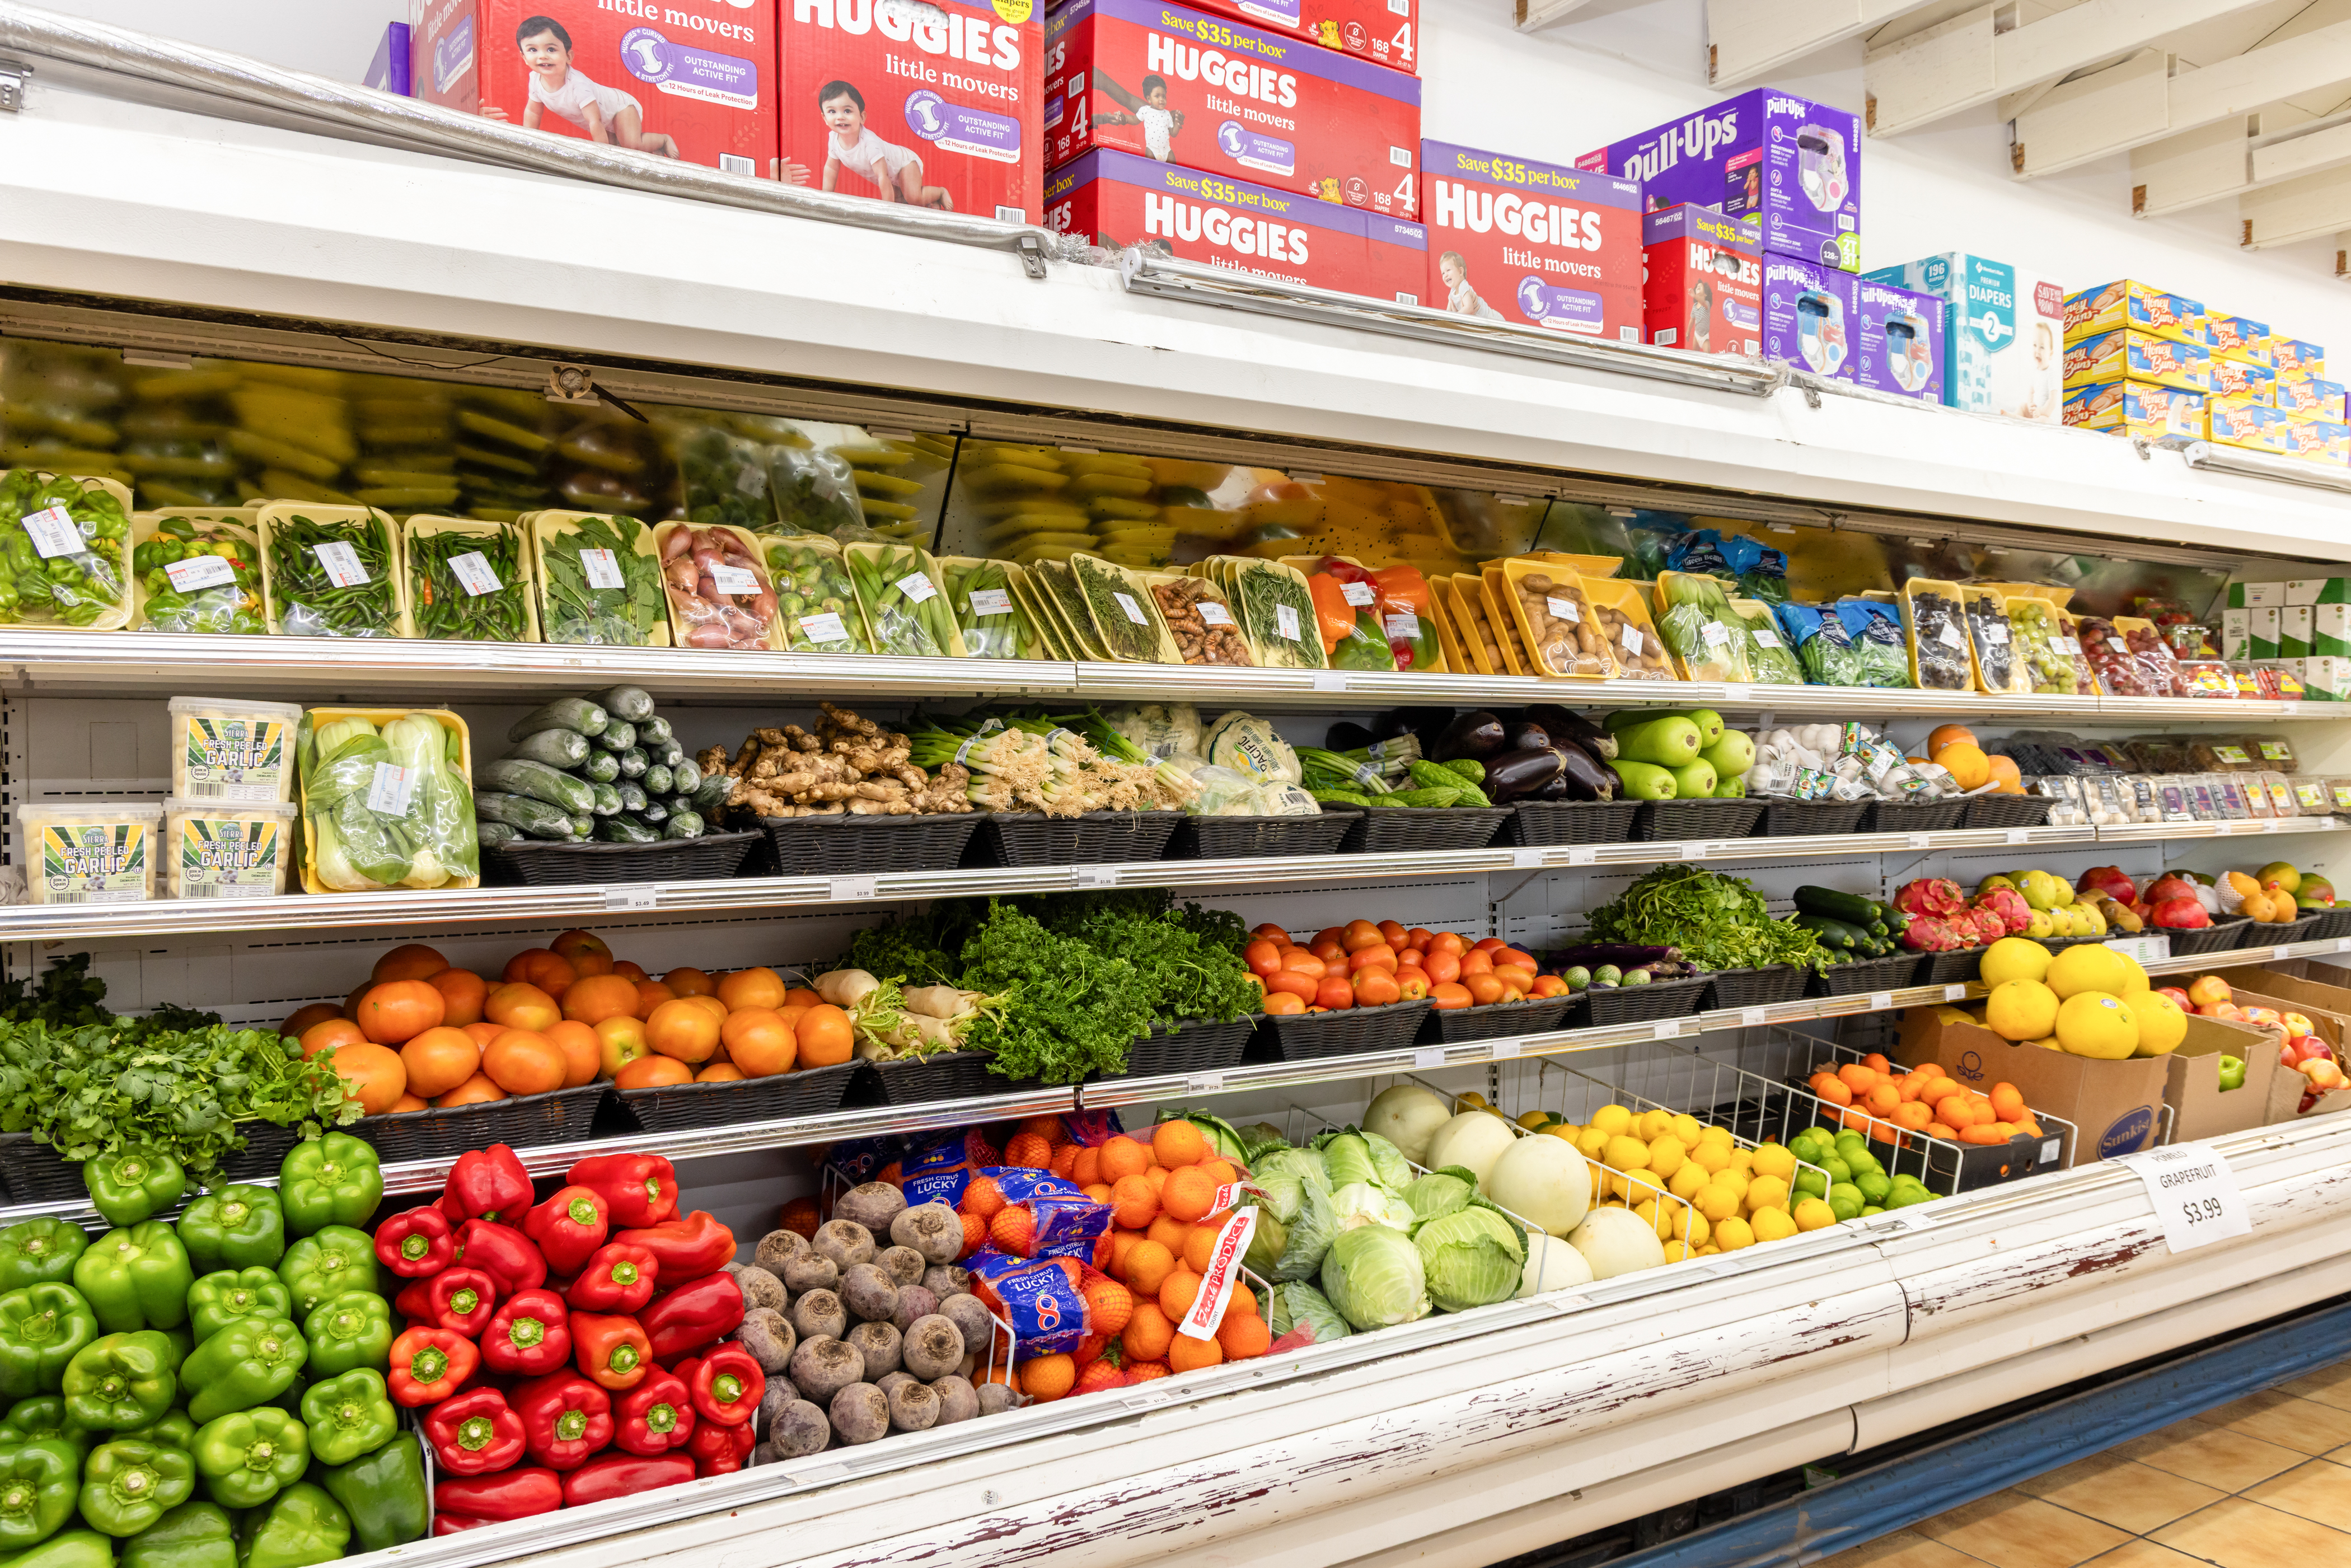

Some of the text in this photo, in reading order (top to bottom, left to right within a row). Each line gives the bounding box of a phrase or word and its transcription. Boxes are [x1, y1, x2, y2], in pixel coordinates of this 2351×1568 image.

[664, 8, 754, 43] movers
[1277, 13, 1297, 25] Protection
[642, 29, 666, 44] CURVED
[1162, 11, 1195, 32] Save
[1196, 18, 1231, 46] $35
[1233, 35, 1256, 50] per
[1372, 38, 1389, 53] 168
[1391, 22, 1413, 61] 4
[1373, 51, 1388, 60] DIAPERS
[641, 68, 670, 82] STRETCHY
[684, 56, 746, 76] OUTSTANDING
[692, 67, 738, 83] ACTIVE FIT
[1148, 32, 1297, 107] HUGGIES
[886, 54, 1019, 101] little movers
[677, 85, 696, 96] Hours
[705, 90, 720, 99] Leak
[721, 93, 753, 106] Protection
[923, 91, 943, 104] CURVED
[1071, 95, 1088, 140] 4
[1206, 93, 1295, 131] little movers
[958, 115, 1010, 133] OUTSTANDING
[965, 124, 1004, 140] ACTIVE FIT
[921, 128, 947, 140] STRETCHY
[952, 142, 967, 151] Hours
[975, 146, 988, 154] Leak
[989, 148, 1016, 160] Protection
[1057, 135, 1070, 152] 168
[1253, 139, 1289, 153] OUTSTANDING
[1258, 147, 1275, 156] ACTIVE
[1273, 165, 1291, 174] Protection
[1457, 153, 1489, 174] Save
[1491, 157, 1525, 184] $35
[1528, 170, 1549, 185] per
[1167, 171, 1198, 193] Save
[1201, 177, 1235, 204] $35
[1237, 192, 1259, 208] per
[1393, 173, 1416, 212] 4
[1613, 181, 1637, 193] 5646602
[1374, 191, 1391, 205] 168
[1374, 204, 1389, 213] DIAPERS
[1435, 180, 1602, 251] HUGGIES
[1145, 193, 1309, 265] HUGGIES
[1697, 218, 1746, 245] Save $35 per
[1503, 246, 1601, 279] little movers
[1928, 263, 1945, 277] 196
[1557, 294, 1596, 306] OUTSTANDING
[1717, 280, 1759, 302] little movers
[1969, 284, 2012, 308] DIAPERS
[2038, 285, 2055, 301] SAVE
[1562, 303, 1582, 312] ACTIVE
[2142, 293, 2170, 315] Honey
[1988, 317, 1996, 335] 2
[2150, 308, 2179, 328] Buns
[2210, 318, 2237, 336] Honey
[2218, 332, 2245, 350] Buns
[2273, 341, 2296, 359] Honey
[2142, 340, 2171, 364] Honey
[2151, 359, 2183, 375] Buns
[2279, 354, 2302, 371] Buns
[2222, 377, 2251, 395] Buns
[2288, 381, 2314, 401] Honey
[2138, 390, 2169, 413] Honey
[2296, 395, 2321, 412] Buns
[2224, 408, 2252, 427] Honey
[2234, 421, 2261, 439] Buns
[2291, 424, 2317, 443] Honey
[2298, 437, 2325, 454] Buns
[1685, 556, 1702, 566] Green
[1868, 626, 1888, 634] Green
[224, 728, 249, 738] SIERRA
[203, 739, 268, 751] FRESH PEELED
[1240, 724, 1280, 771] CAULIFLOWER CHOU-FLEUR
[206, 750, 264, 767] GARLIC
[1238, 736, 1267, 773] PACIFIC
[82, 834, 109, 843] SIERRA
[219, 829, 243, 838] SIERRA
[60, 845, 129, 856] FRESH PEELED
[198, 840, 262, 850] FRESH PEELED
[64, 856, 126, 874] GARLIC
[200, 851, 258, 867] GARLIC
[2102, 1118, 2149, 1154] Sunkist
[2151, 1150, 2188, 1163] POMELO
[913, 1176, 934, 1186] FRESH
[2160, 1164, 2217, 1188] GRAPEFRUIT
[917, 1179, 958, 1195] LUCKY
[2183, 1197, 2222, 1227] $3.99
[1048, 1241, 1085, 1256] FRESH CITRUS
[1007, 1268, 1053, 1286] FRESH CITRUS
[1197, 1220, 1245, 1324] Fresh PRODUCE
[1015, 1272, 1055, 1291] LUCKY
[1036, 1294, 1060, 1331] 8
[1209, 1311, 1219, 1328] COUNT
